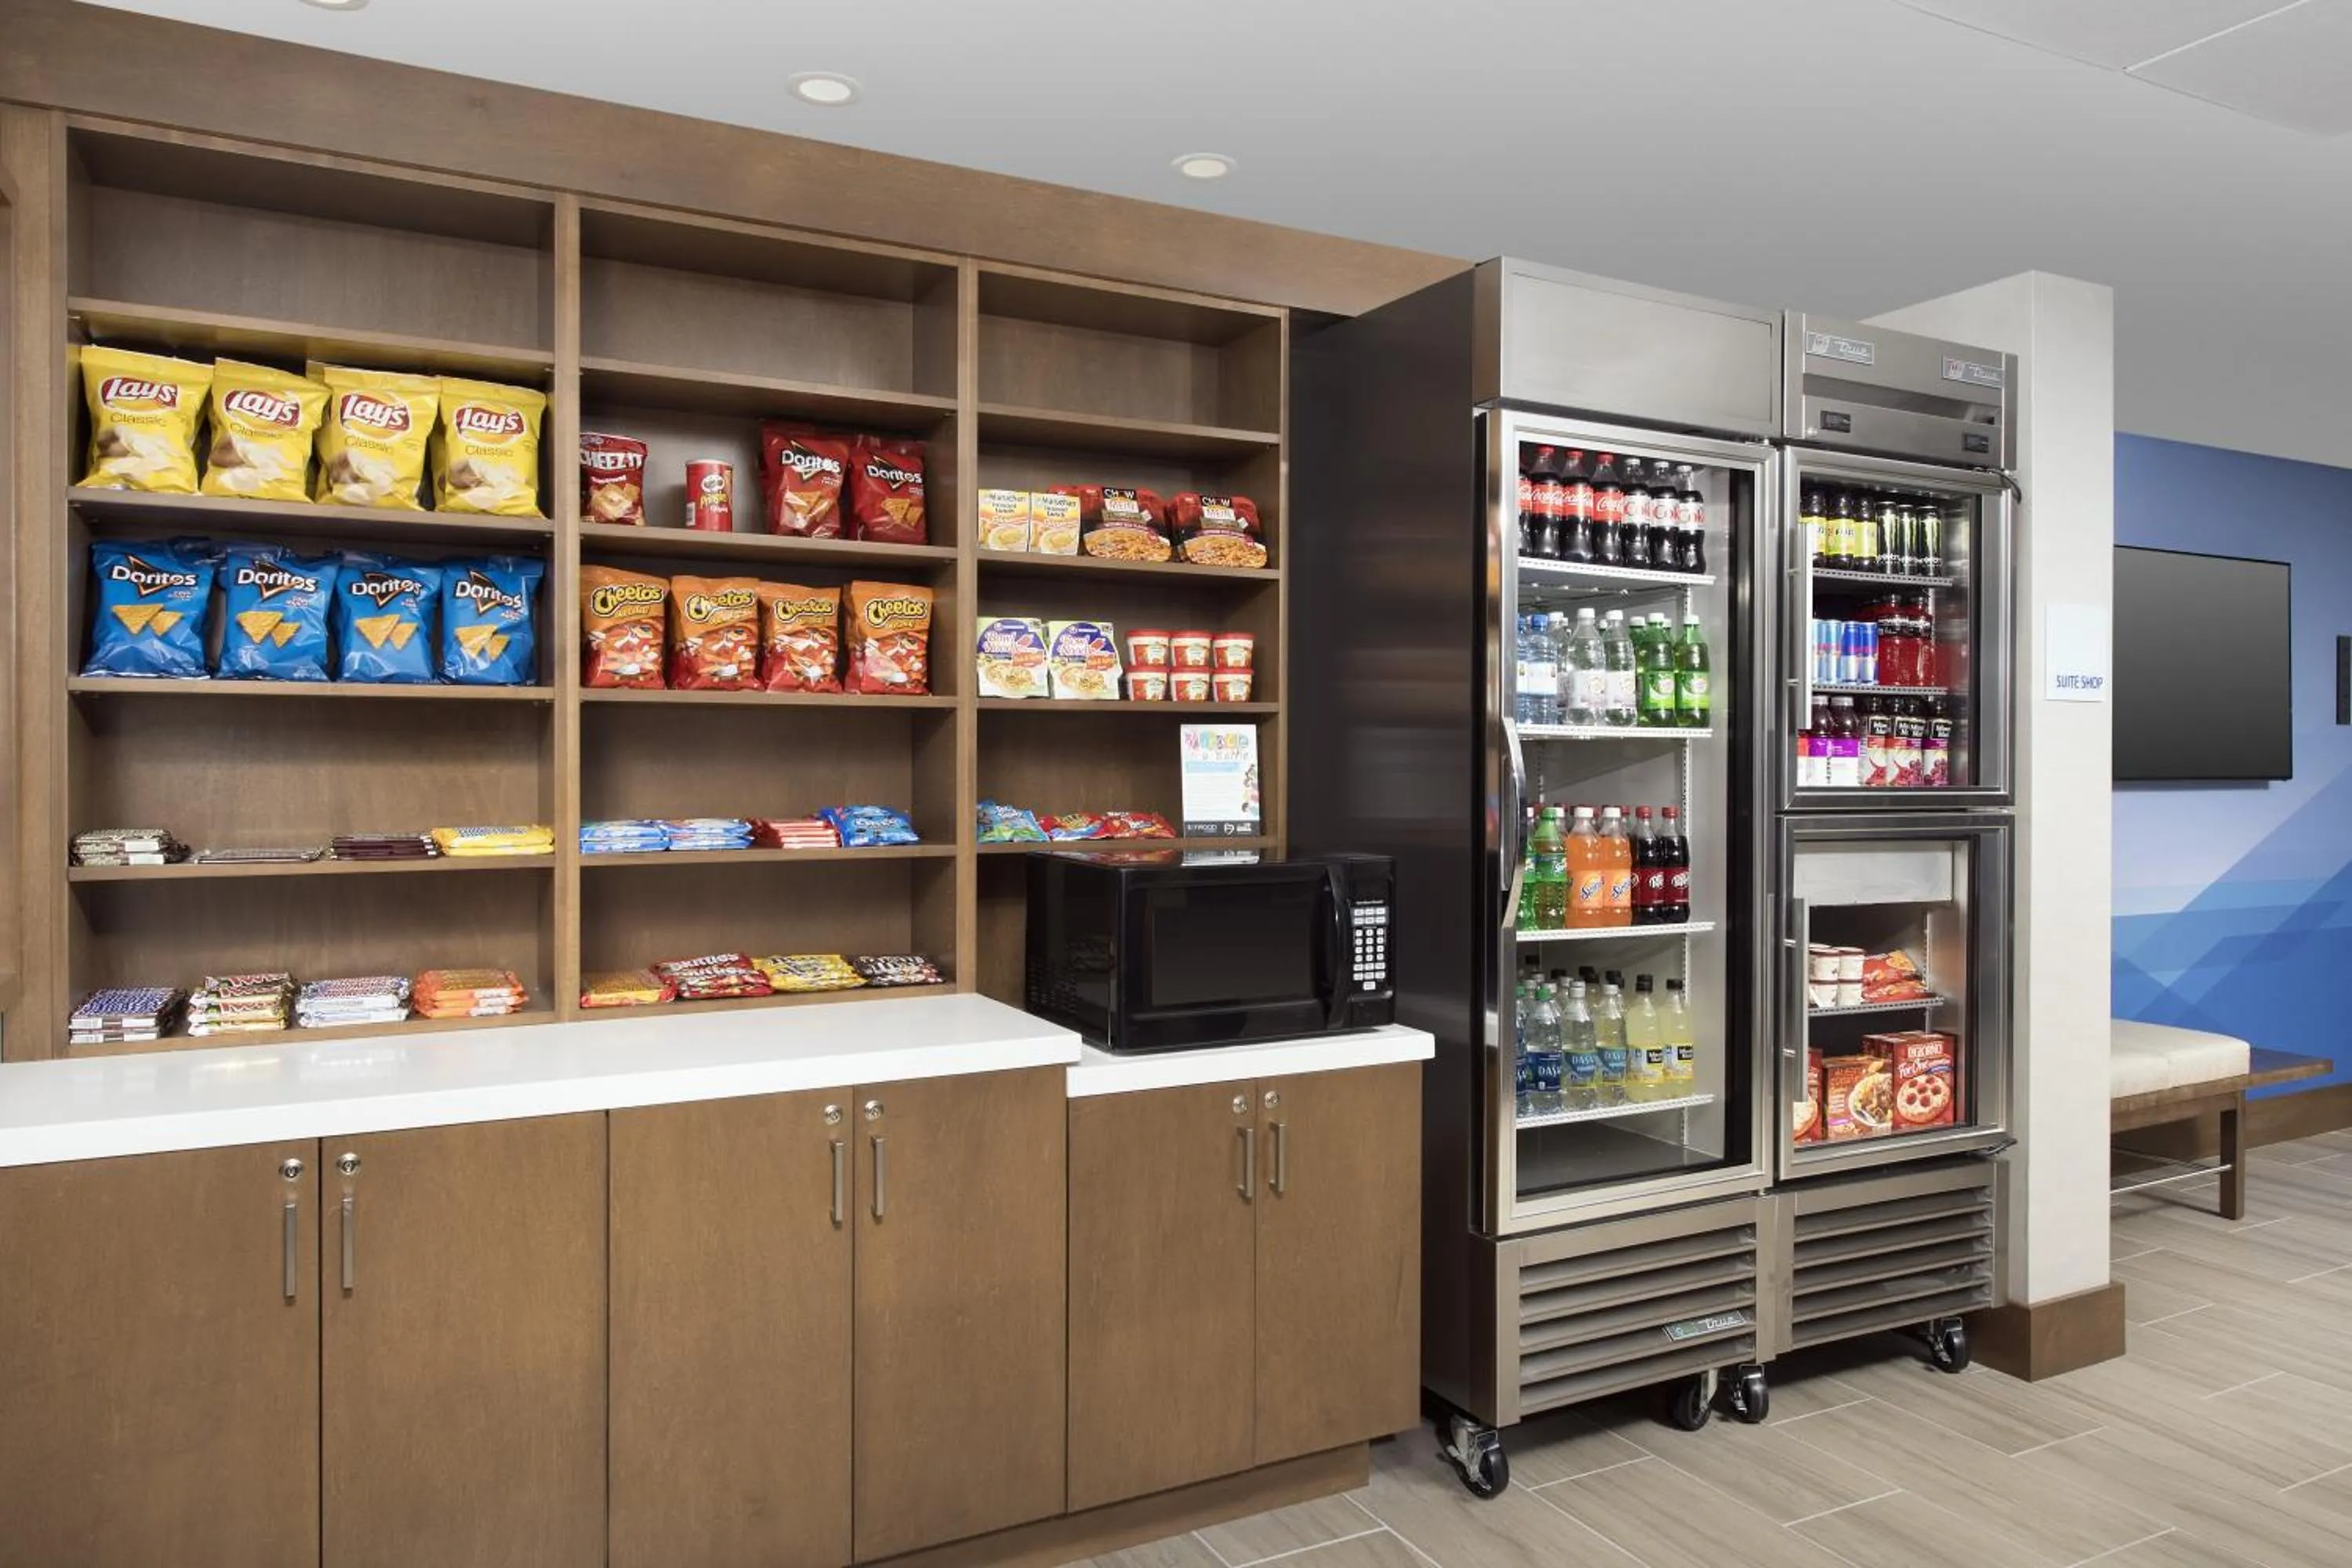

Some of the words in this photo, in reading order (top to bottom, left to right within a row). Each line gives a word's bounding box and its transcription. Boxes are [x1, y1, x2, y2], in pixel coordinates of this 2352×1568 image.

[782, 449, 841, 474] Doritos
[867, 464, 923, 484] Doritos
[112, 565, 197, 586] Doritos
[238, 568, 318, 593] Doritos
[352, 581, 423, 596] Doritos
[456, 581, 522, 609] Doritos
[593, 586, 662, 615] Cheetos
[688, 591, 753, 620] Cheetos
[776, 600, 833, 619] Cheetos
[867, 600, 925, 625] Cheetos
[2056, 675, 2080, 689] SUITE
[2082, 675, 2104, 689] SHOP
